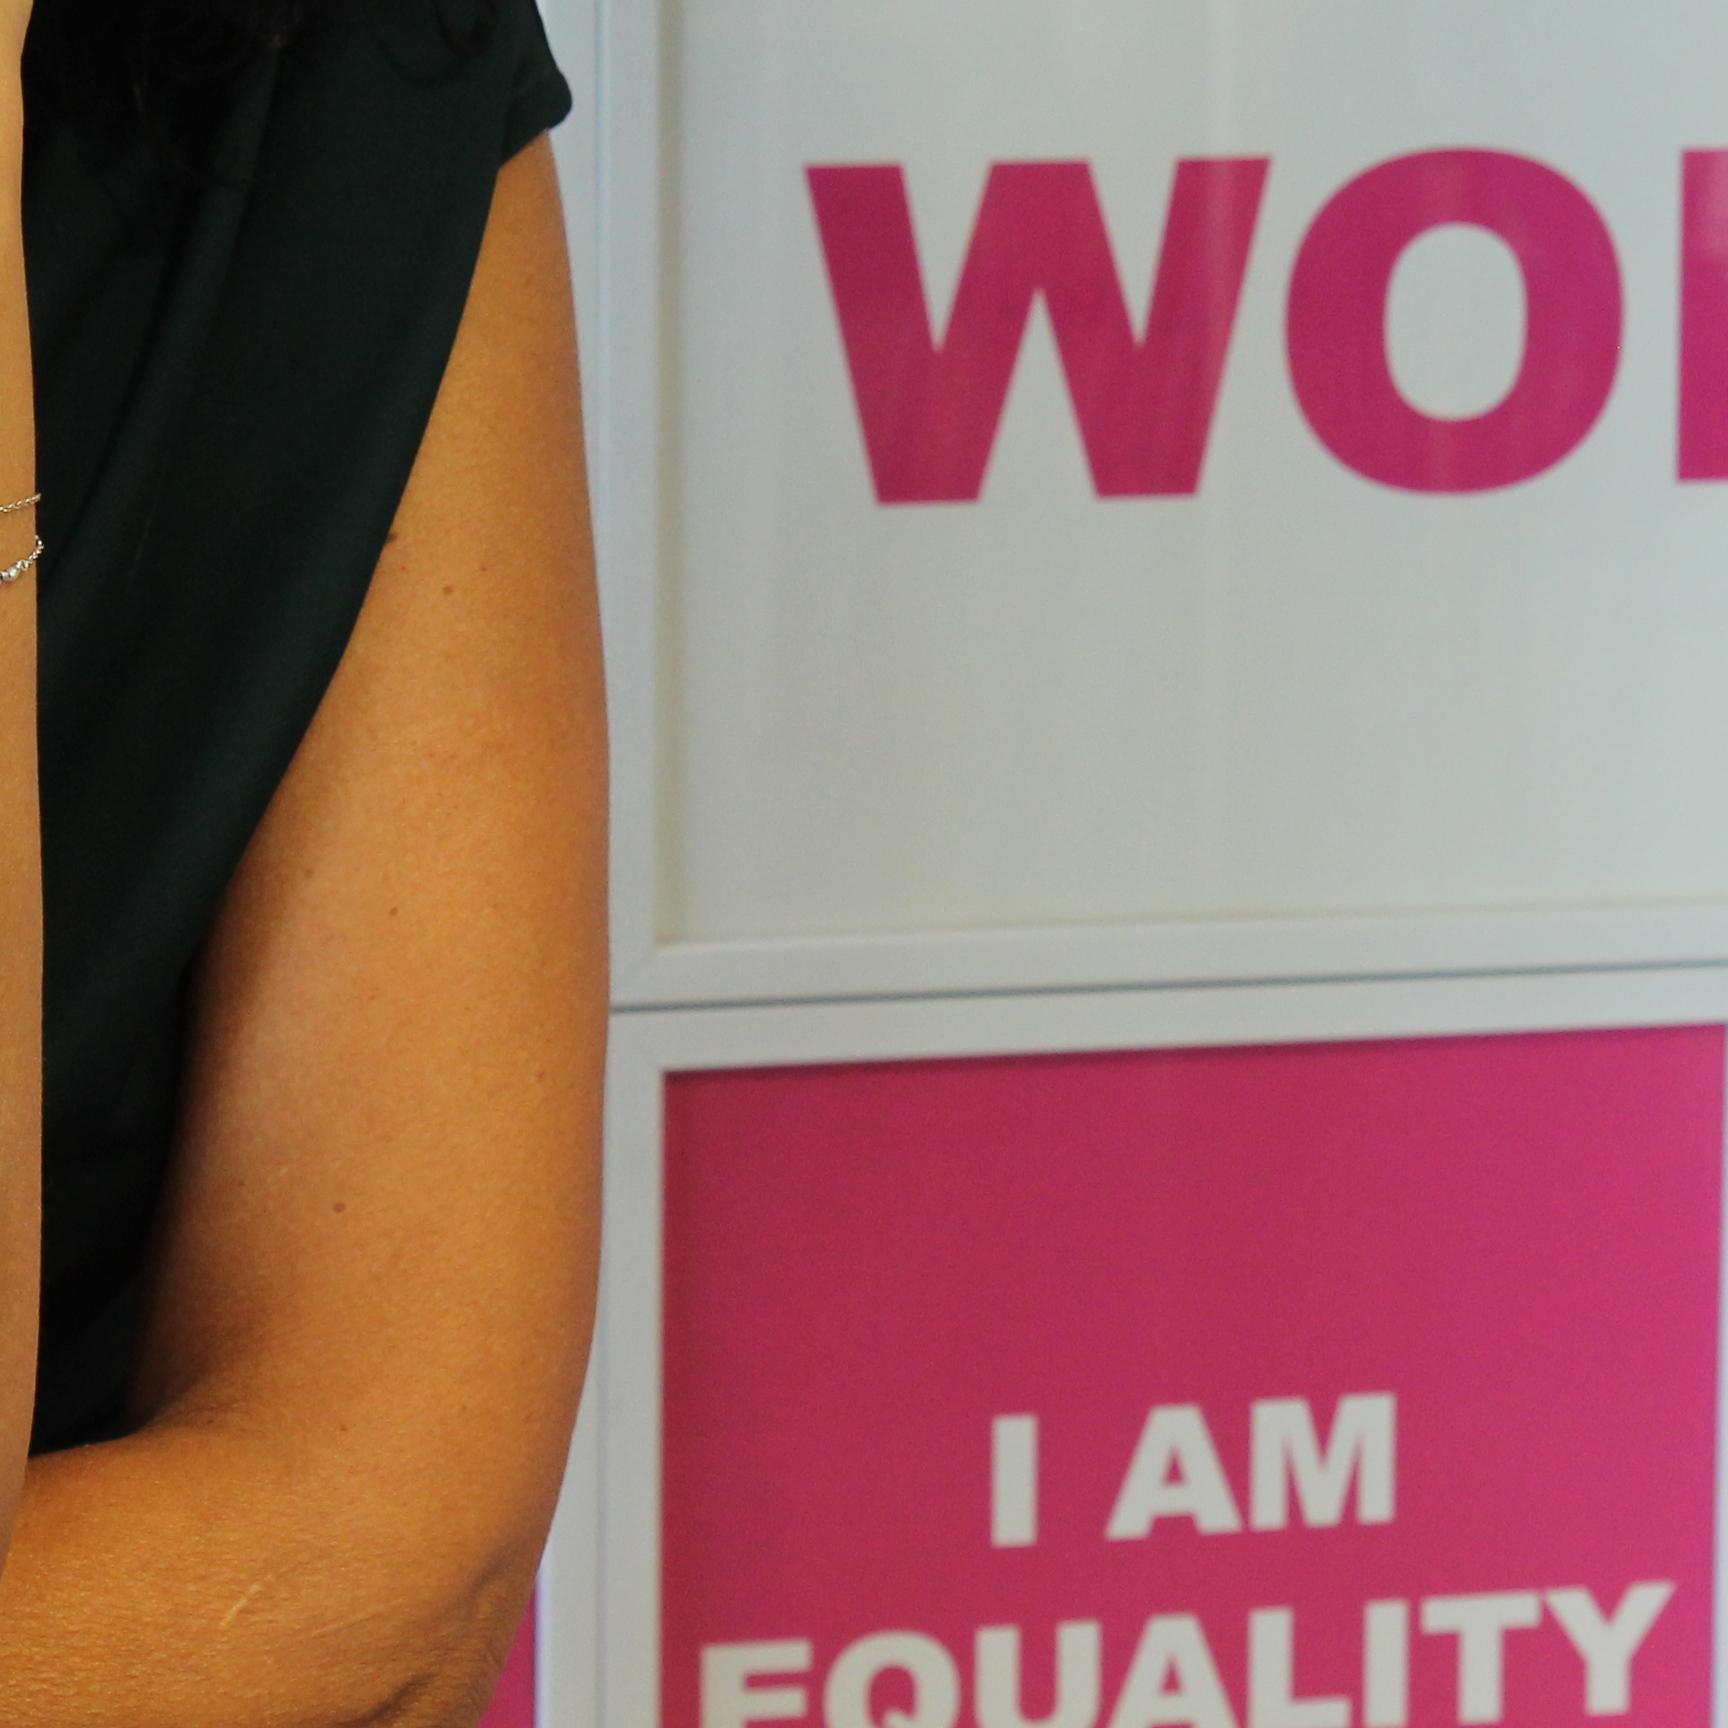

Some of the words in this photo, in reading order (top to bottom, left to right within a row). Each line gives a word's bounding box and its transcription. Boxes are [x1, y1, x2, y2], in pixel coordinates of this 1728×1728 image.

[992, 1414, 1038, 1547] I
[1106, 1392, 1397, 1540] AM
[701, 1581, 1674, 1728] EQUALITY
